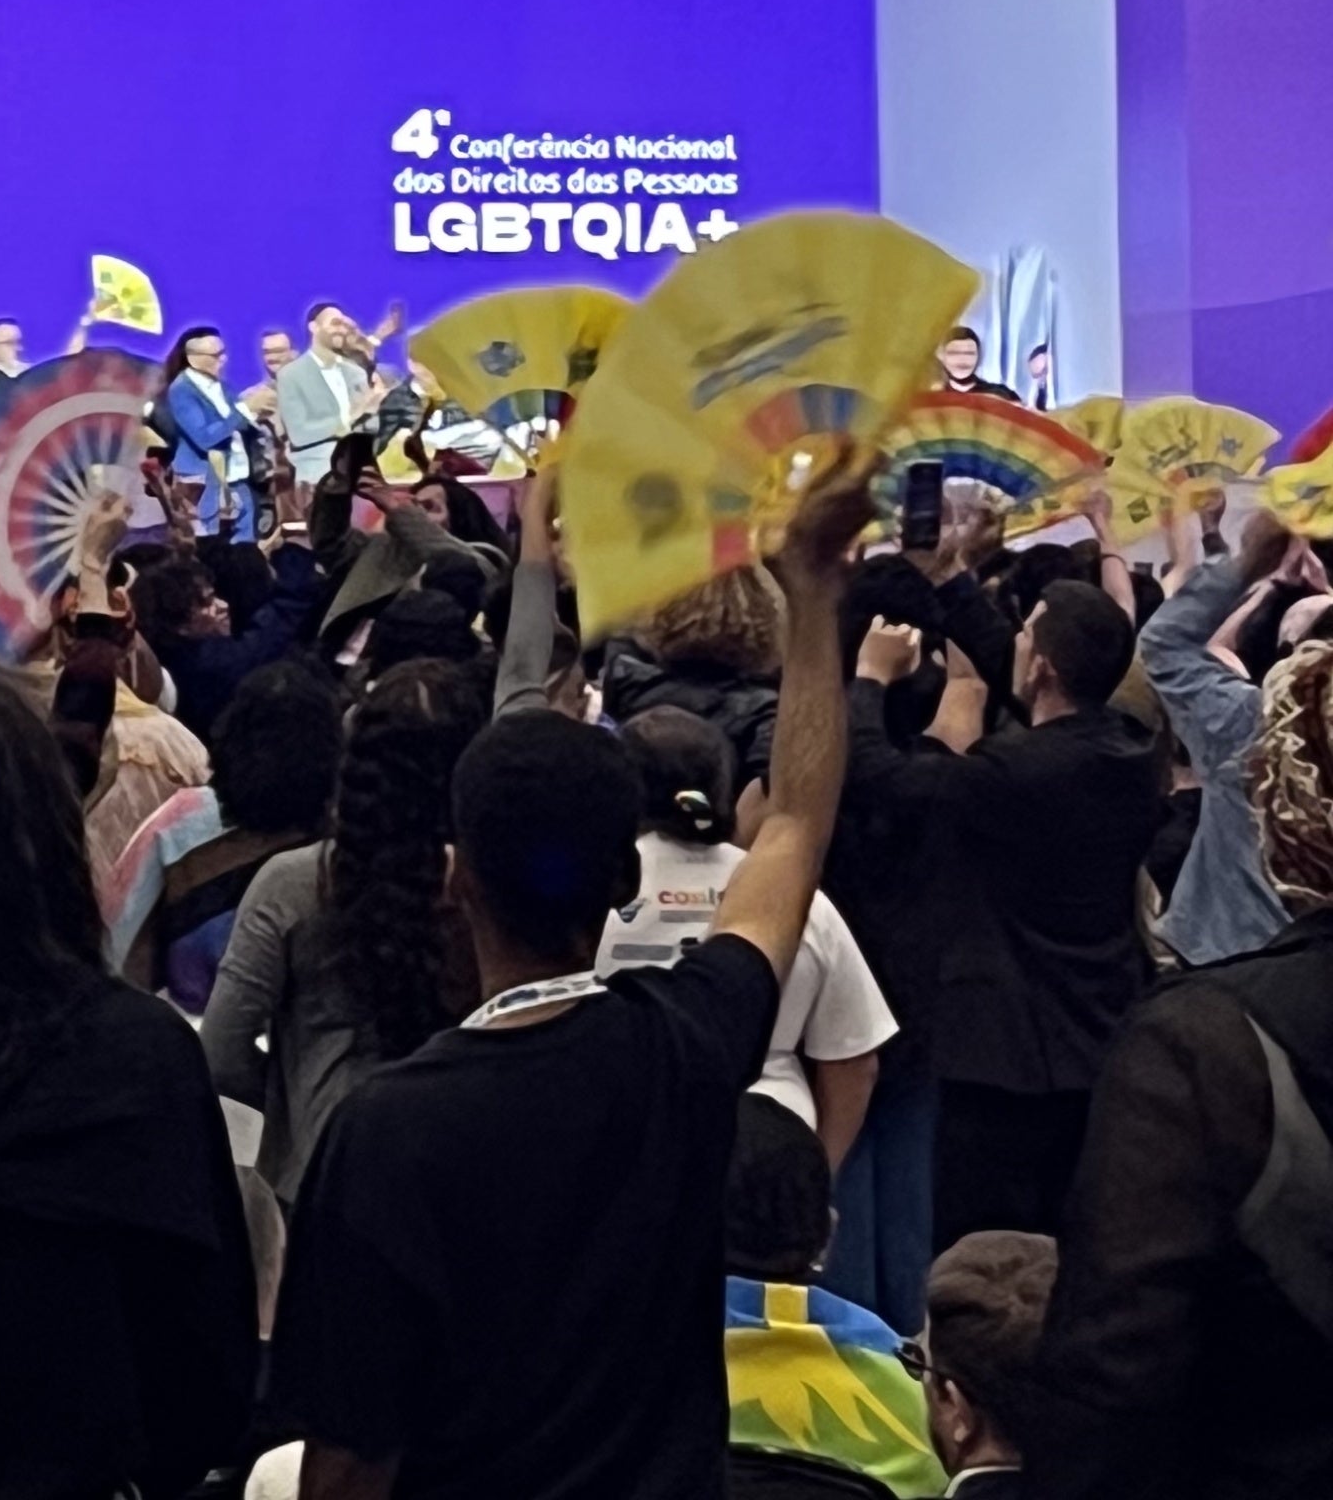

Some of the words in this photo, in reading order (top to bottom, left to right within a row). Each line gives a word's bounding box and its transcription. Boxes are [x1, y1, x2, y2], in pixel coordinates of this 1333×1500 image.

[449, 132, 611, 164] Conferência
[614, 134, 738, 160] Nacional
[393, 167, 445, 194] dos
[451, 165, 561, 194] Direitos
[567, 167, 619, 194] dos
[624, 168, 738, 195] Pessoas
[393, 202, 739, 260] LGBTQIA+
